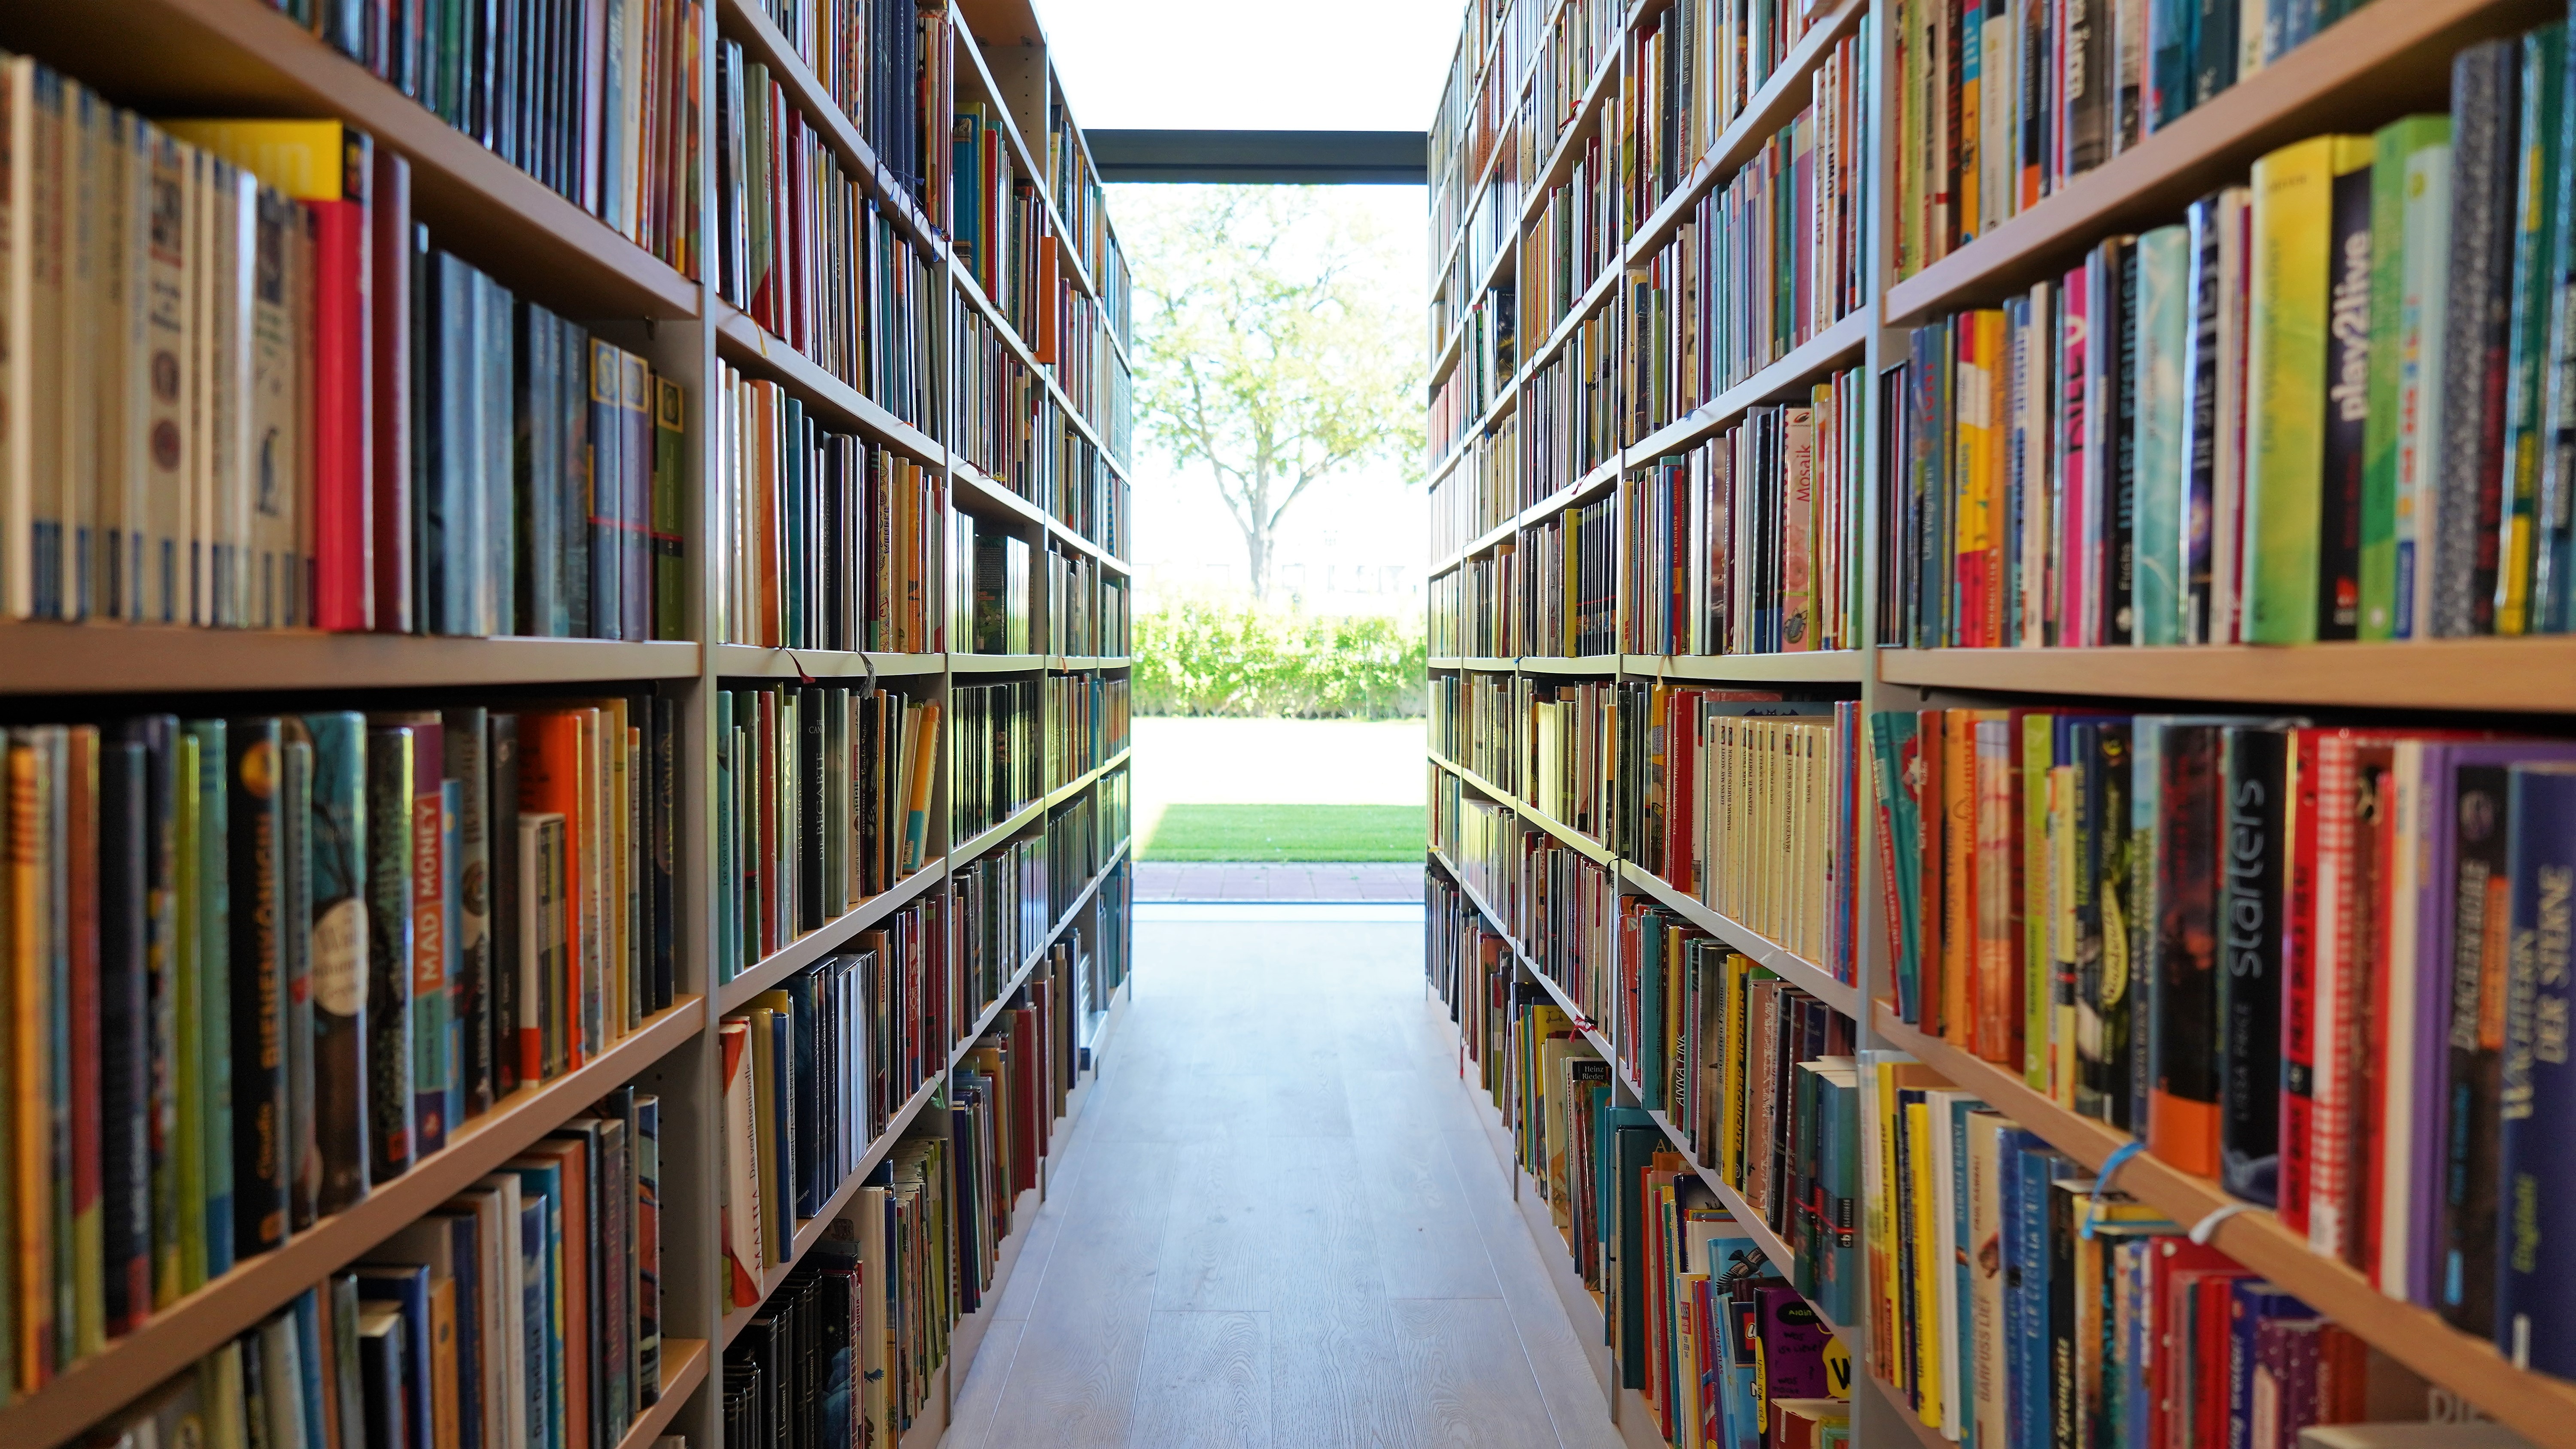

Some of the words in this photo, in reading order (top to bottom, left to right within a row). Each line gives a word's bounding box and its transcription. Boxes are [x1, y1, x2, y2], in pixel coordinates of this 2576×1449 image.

[2330, 230, 2371, 422] play2live
[1795, 444, 1811, 503] Mosaik
[816, 753, 824, 835] BEGABTE
[417, 803, 439, 897] MONEY
[2227, 779, 2263, 979] starters
[419, 911, 439, 982] MAD
[1677, 1032, 1685, 1063] FINK
[2535, 995, 2569, 1064] DER
[744, 1064, 756, 1154] verhängnisvolle
[1675, 1067, 1684, 1106] ANNA
[748, 1156, 756, 1179] Das
[1715, 1327, 1723, 1375] WELTATLAS
